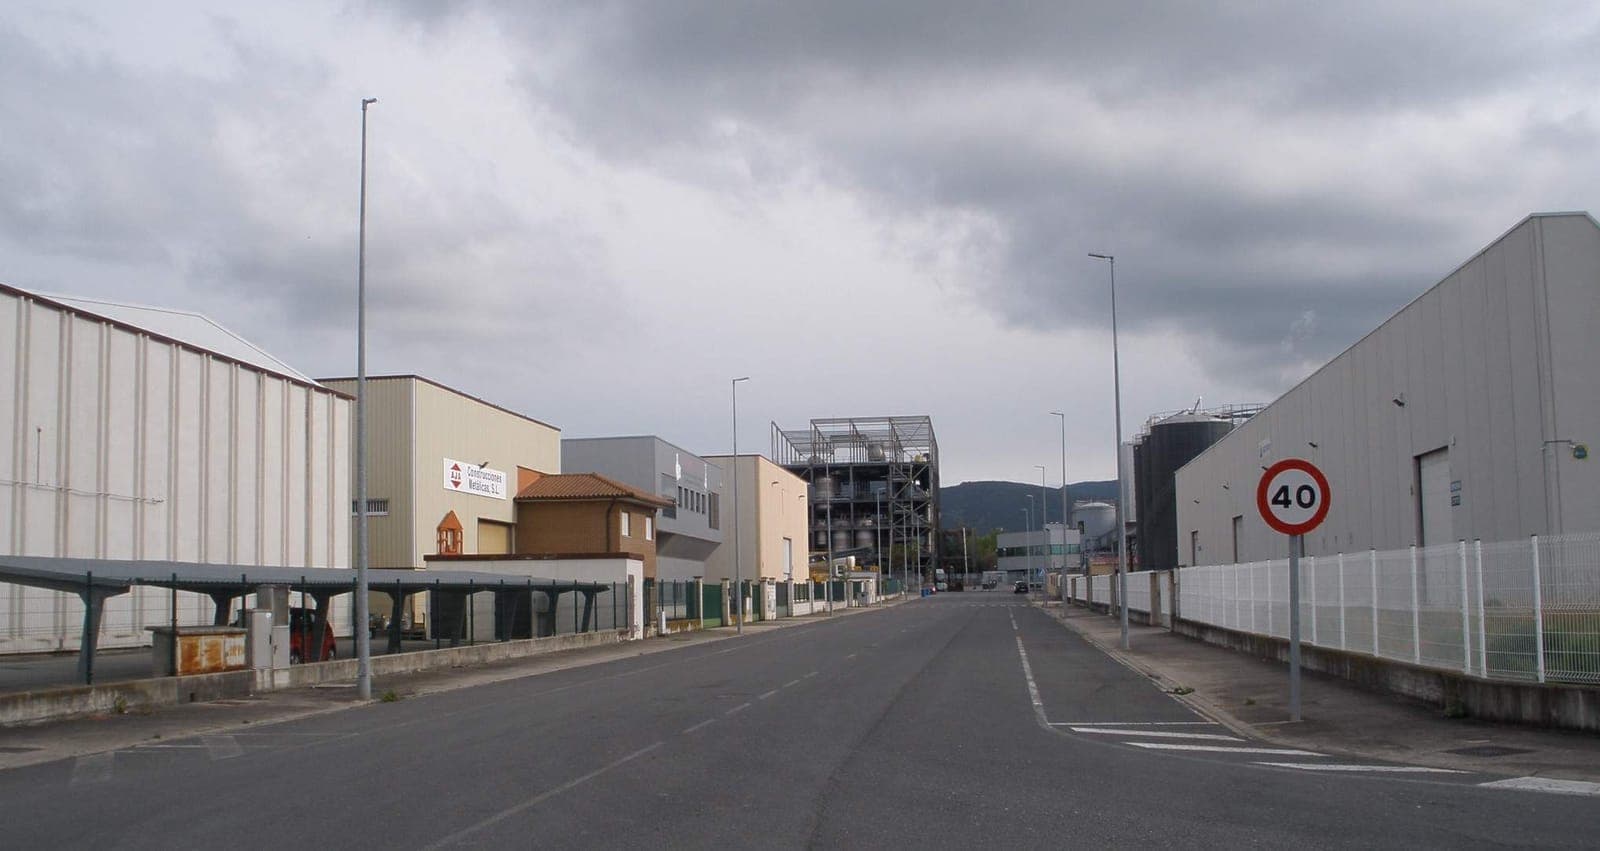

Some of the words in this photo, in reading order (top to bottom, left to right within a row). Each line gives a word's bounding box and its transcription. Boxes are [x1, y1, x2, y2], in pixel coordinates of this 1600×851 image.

[450, 471, 461, 480] AJA
[467, 466, 502, 483] Construcciones
[1271, 484, 1316, 509] 40
